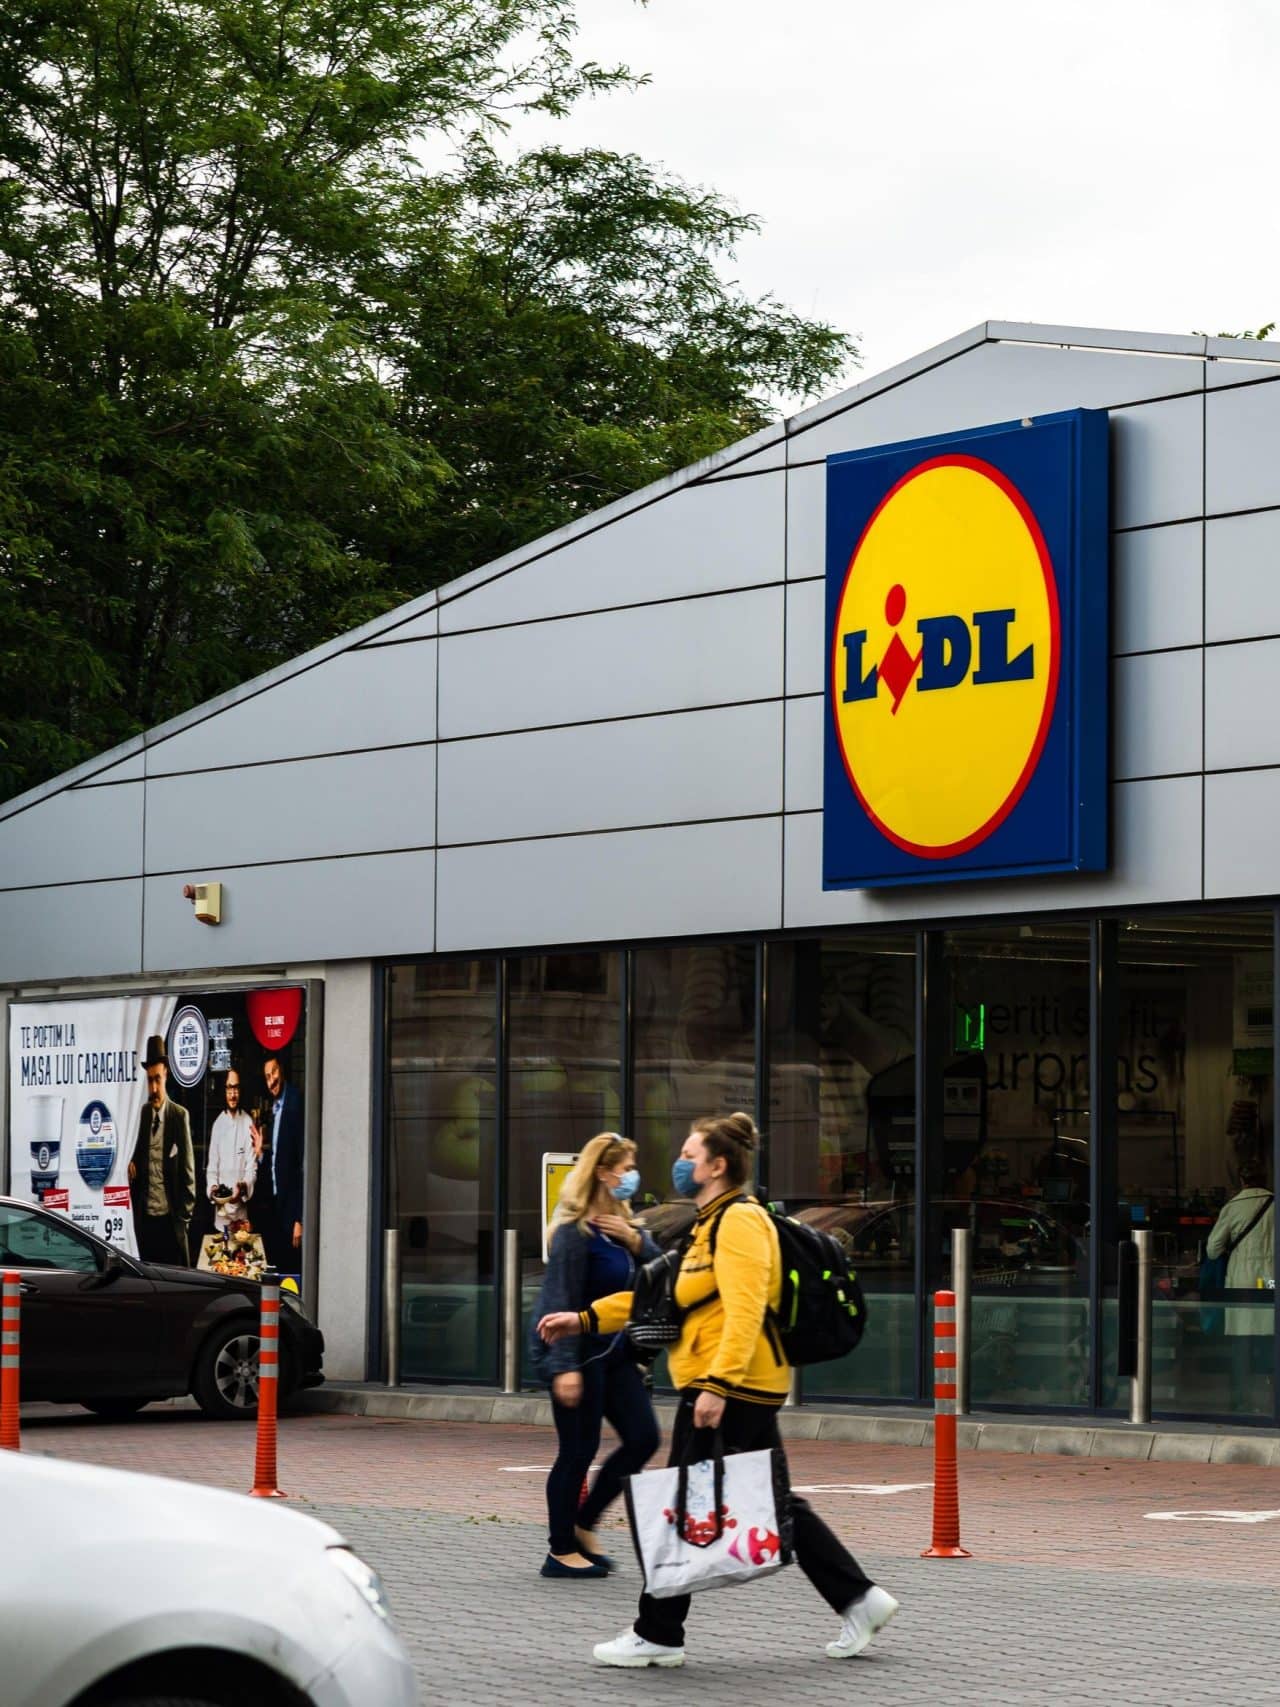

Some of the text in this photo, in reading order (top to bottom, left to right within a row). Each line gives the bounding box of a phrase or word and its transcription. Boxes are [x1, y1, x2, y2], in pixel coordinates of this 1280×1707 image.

[20, 1023, 76, 1049] TE POFTIM LA
[21, 1050, 138, 1087] MASA LUI CARAGIALE
